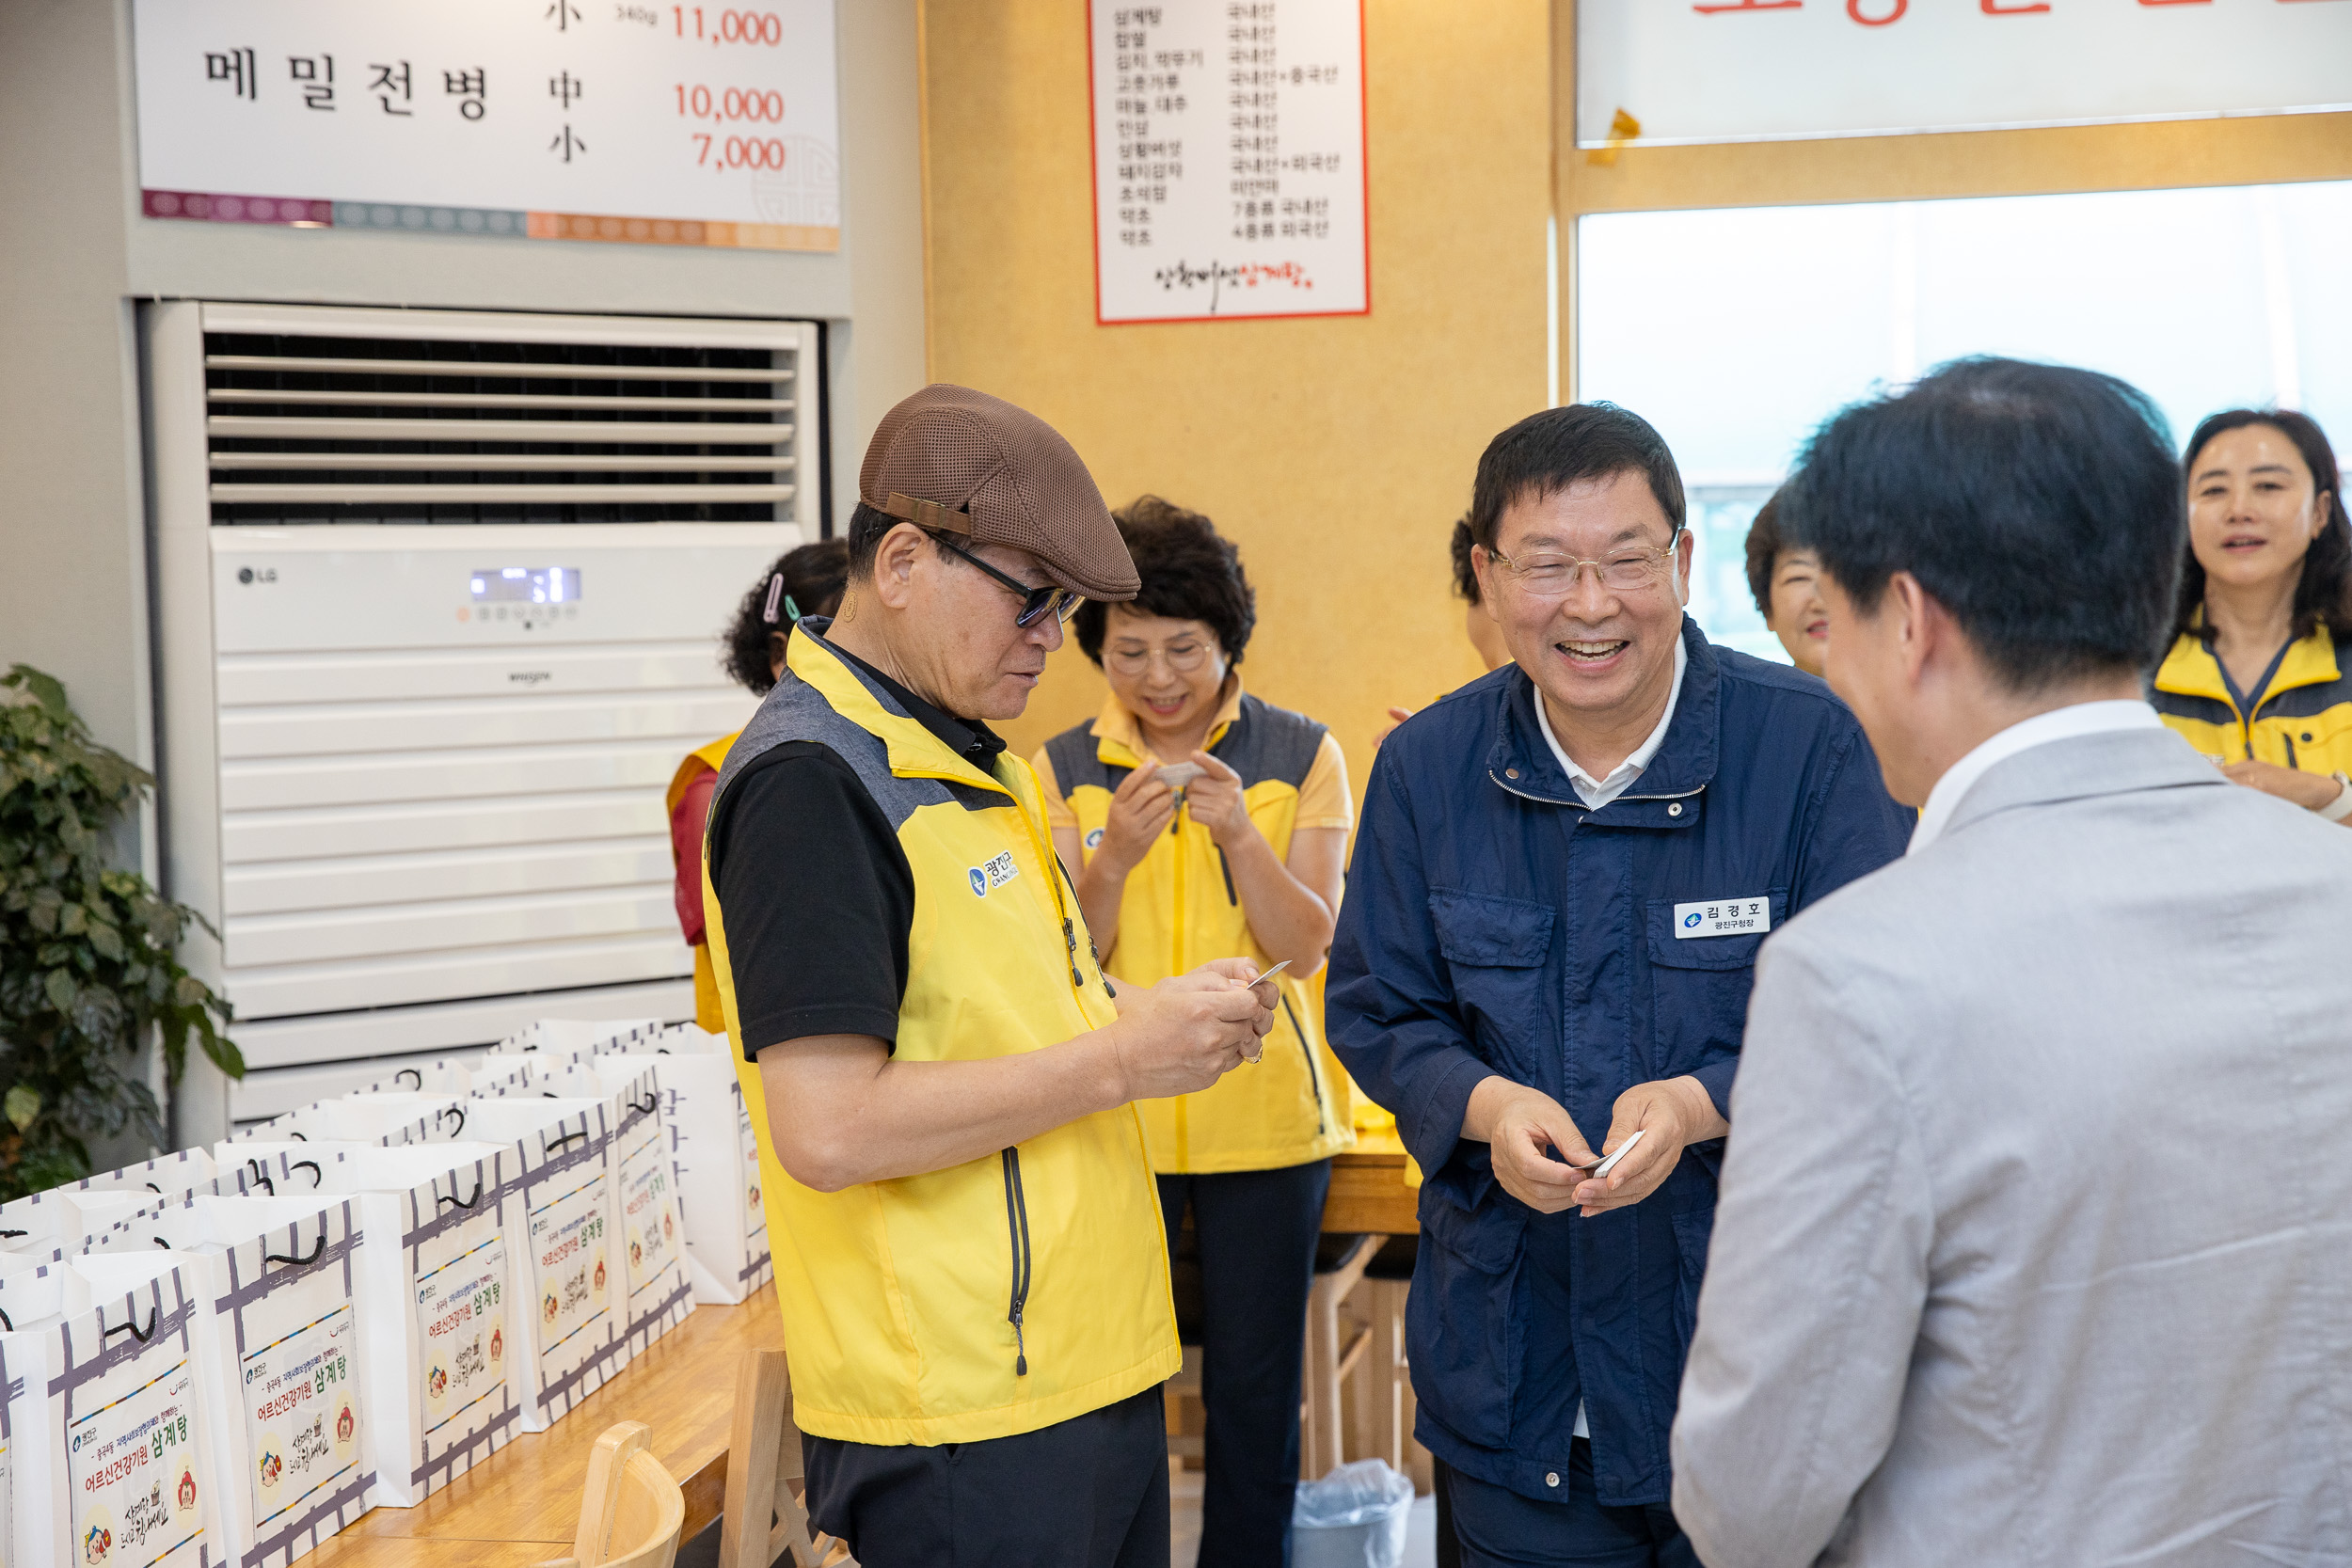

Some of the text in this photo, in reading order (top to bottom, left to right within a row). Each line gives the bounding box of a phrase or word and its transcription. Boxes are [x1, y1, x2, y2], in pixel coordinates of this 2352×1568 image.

[1228, 2, 1275, 20] 국내산
[544, 0, 582, 32] 小
[674, 5, 782, 48] 11,000
[1228, 24, 1276, 42] 국내산
[1229, 46, 1276, 64] 국내산
[549, 70, 581, 109] 中
[674, 82, 785, 124] 10,000
[1230, 90, 1277, 108] 국내산
[1230, 113, 1278, 131] 국내산
[549, 124, 787, 172] 小 7,000
[1231, 135, 1278, 152] 국내산
[984, 851, 1013, 878] 광진구
[1707, 903, 1761, 919] 김경호
[1714, 919, 1755, 930] 광진구청장
[473, 1281, 501, 1316] 삼계탕
[257, 1354, 347, 1422] 어르신건강기원 삼계탕
[85, 1414, 187, 1493] 어르신건강기원 삼계탕
